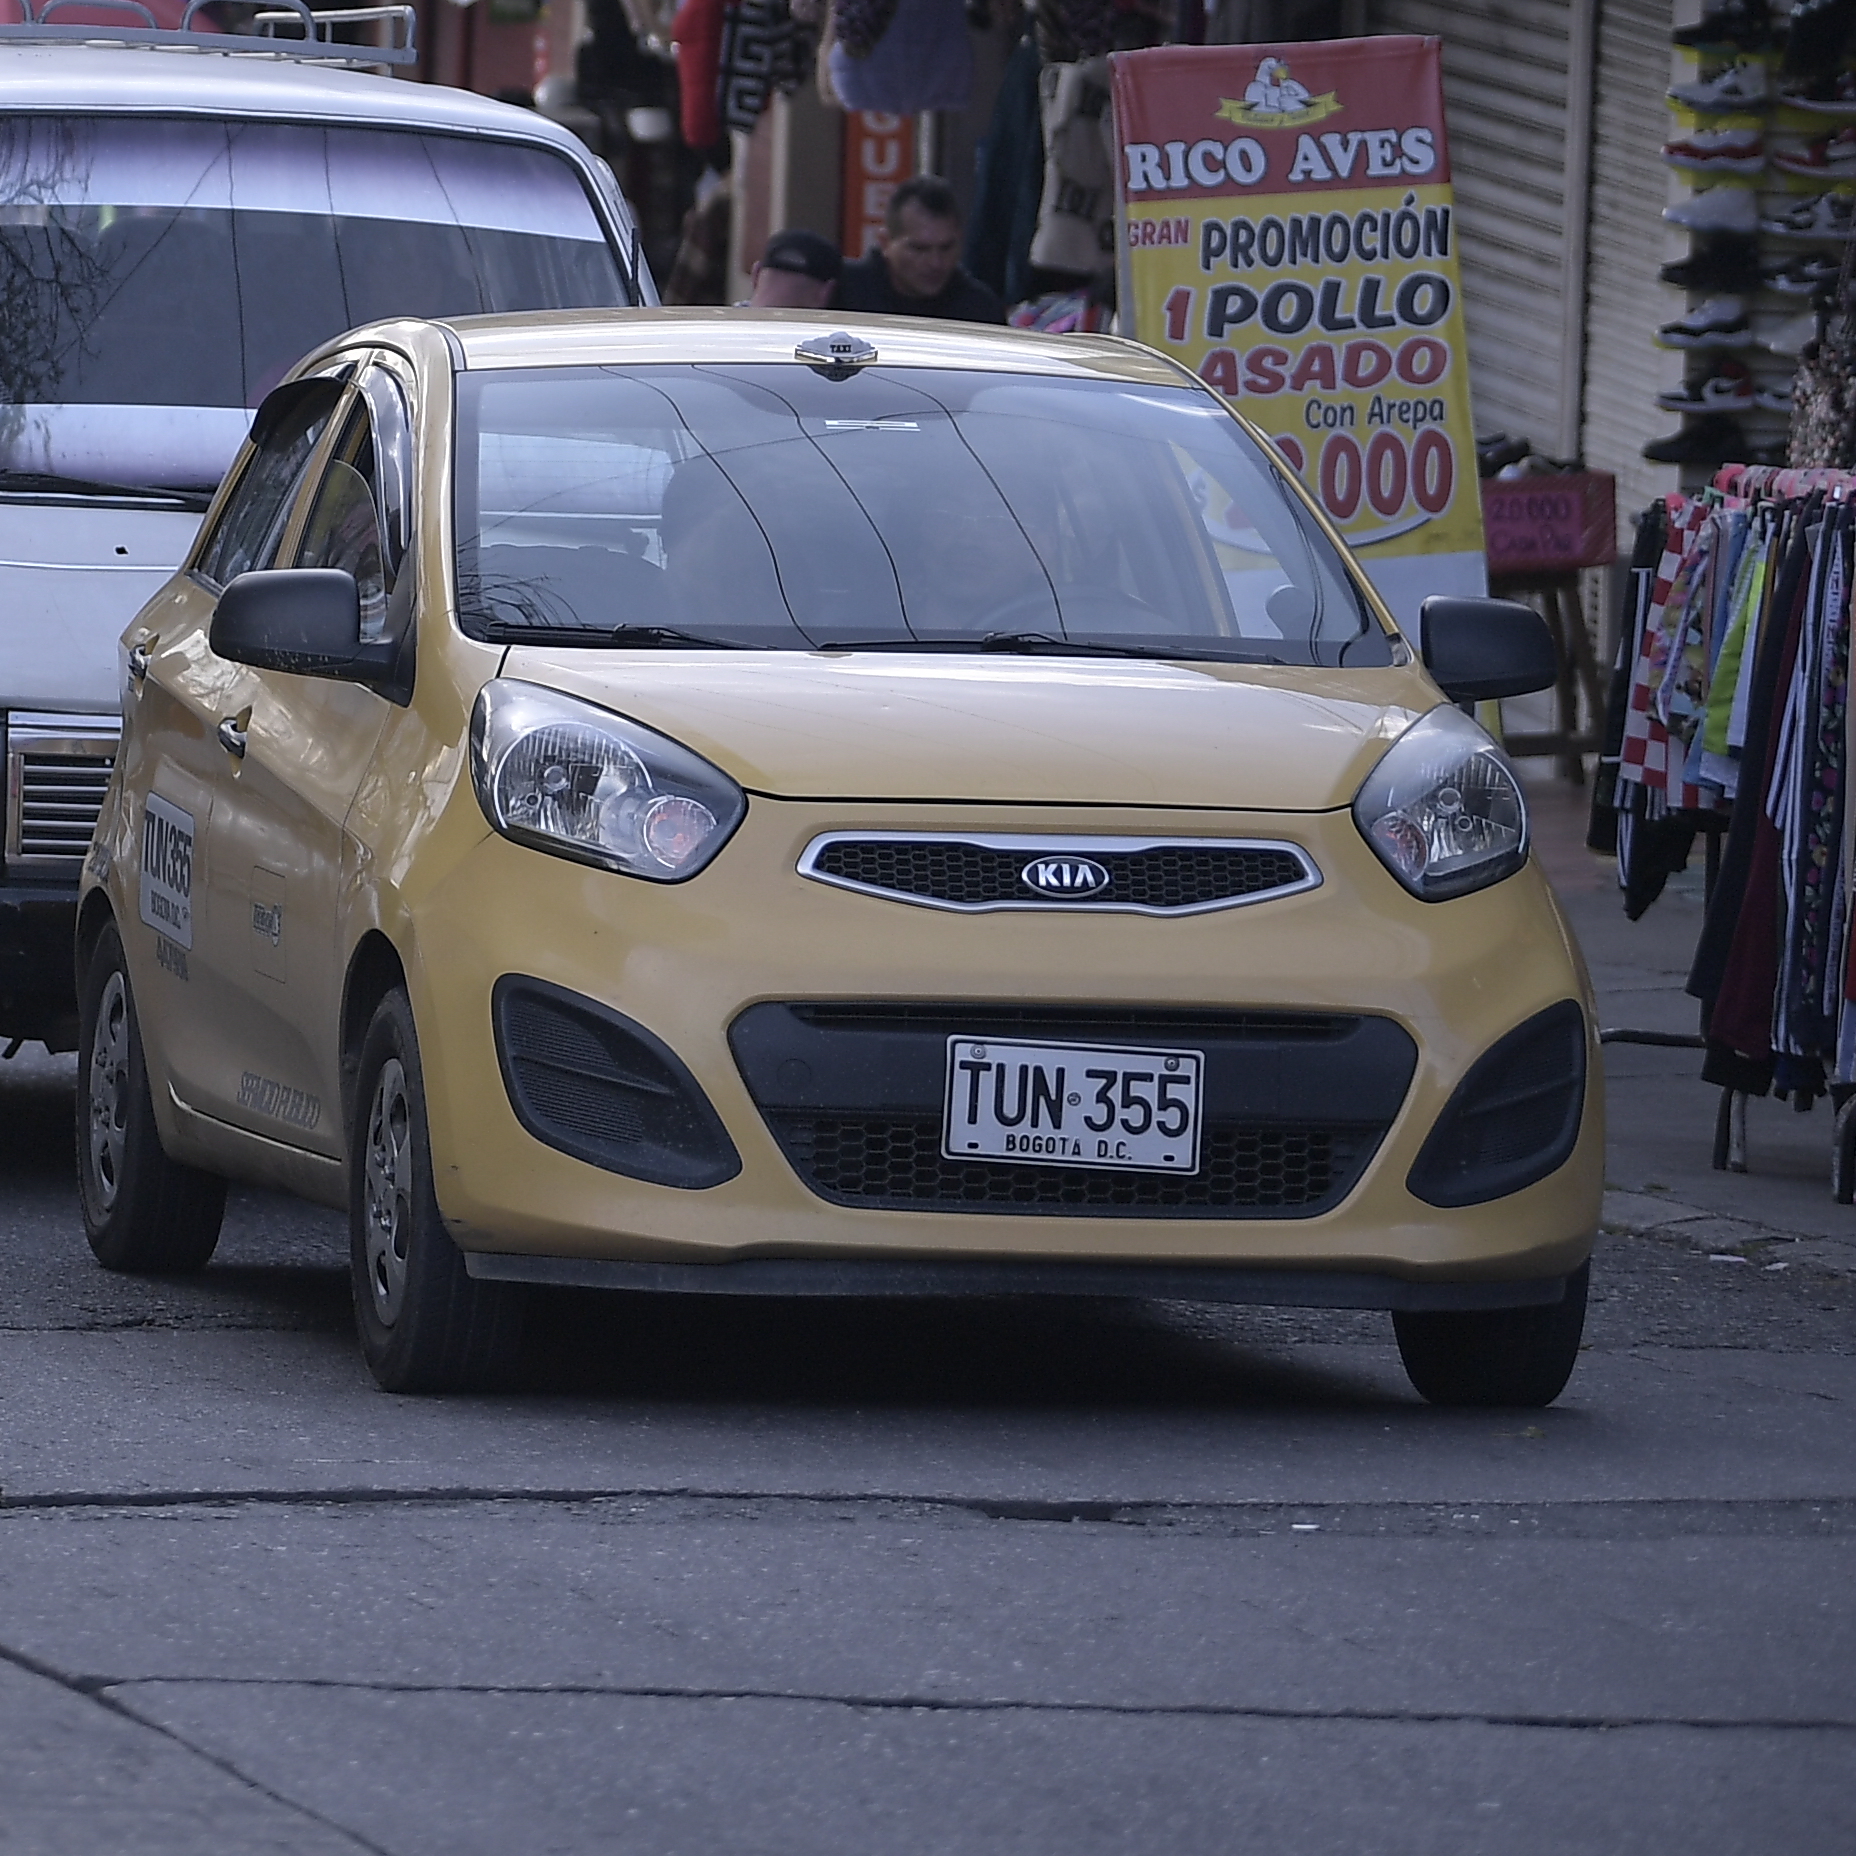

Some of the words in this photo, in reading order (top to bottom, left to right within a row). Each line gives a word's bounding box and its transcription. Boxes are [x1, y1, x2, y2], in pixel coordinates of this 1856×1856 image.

[1124, 137, 1268, 191] RICO
[1288, 126, 1436, 183] AVES
[1128, 217, 1190, 247] GRAN
[1199, 191, 1452, 272] PROMOCIÓN
[1164, 287, 1191, 341] 1
[1205, 273, 1451, 339] POLLO
[1200, 337, 1448, 396] ASADO
[1305, 397, 1355, 430] Con
[1368, 394, 1445, 430] Arepa
[1037, 863, 1097, 888] KIA
[958, 1059, 1067, 1131] TUN
[1083, 1067, 1192, 1139] 355
[1004, 1133, 1082, 1157] BOGOTA
[1096, 1139, 1134, 1162] D.C.
